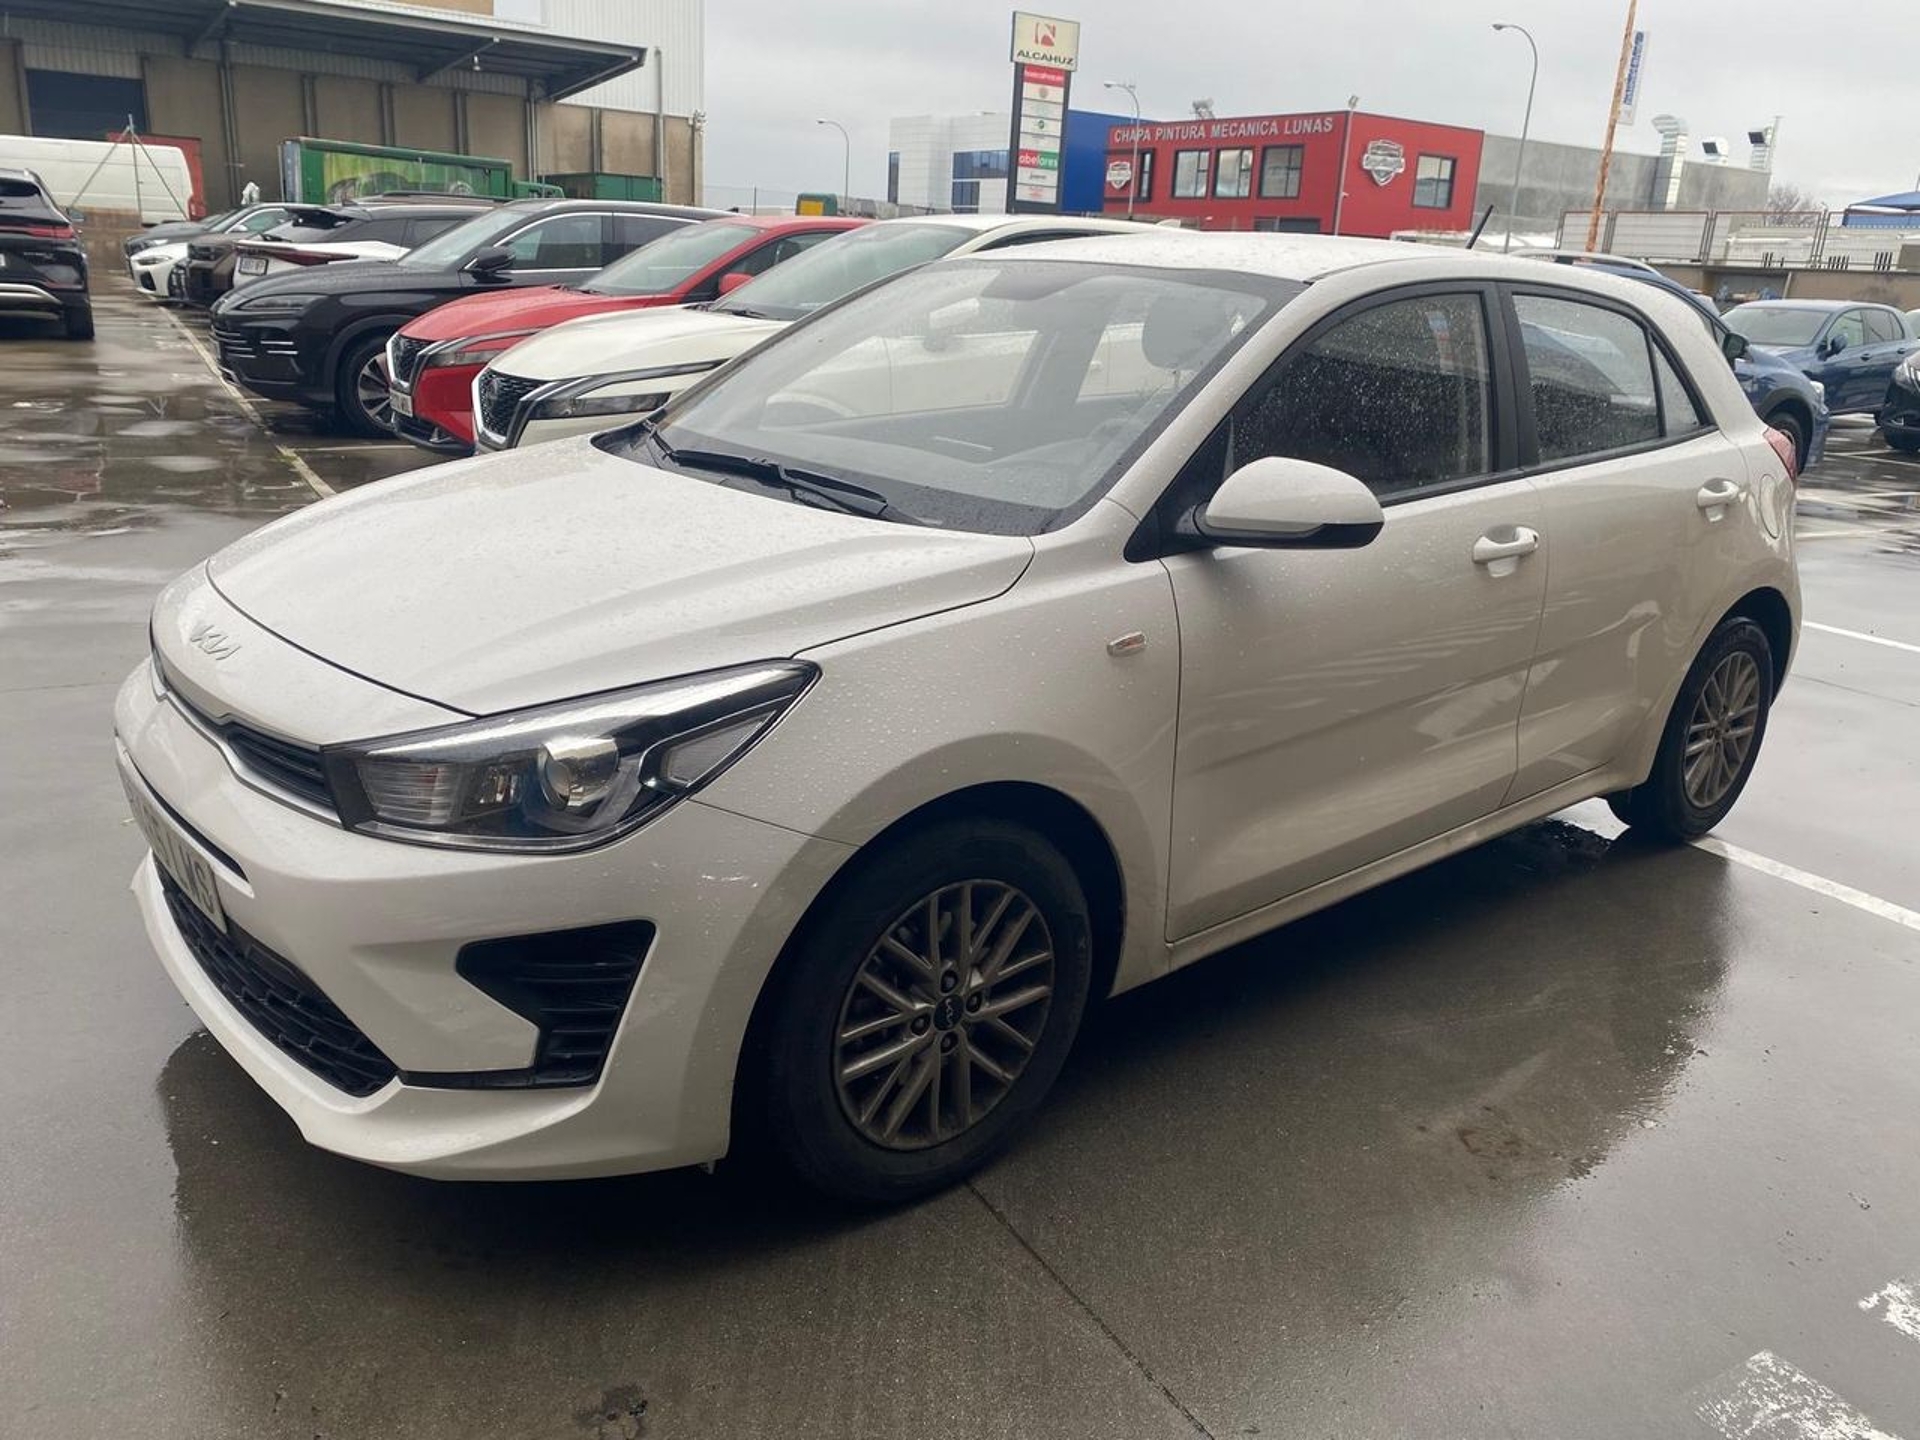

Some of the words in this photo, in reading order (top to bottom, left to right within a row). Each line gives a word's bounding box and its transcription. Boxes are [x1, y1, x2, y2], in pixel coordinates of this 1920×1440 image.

[1017, 50, 1074, 66] ALCAHUZ
[1114, 129, 1151, 143] CHAPA
[1156, 125, 1205, 141] PINTURA
[1212, 121, 1278, 138] MECANICA
[1284, 117, 1333, 135] LUNAS
